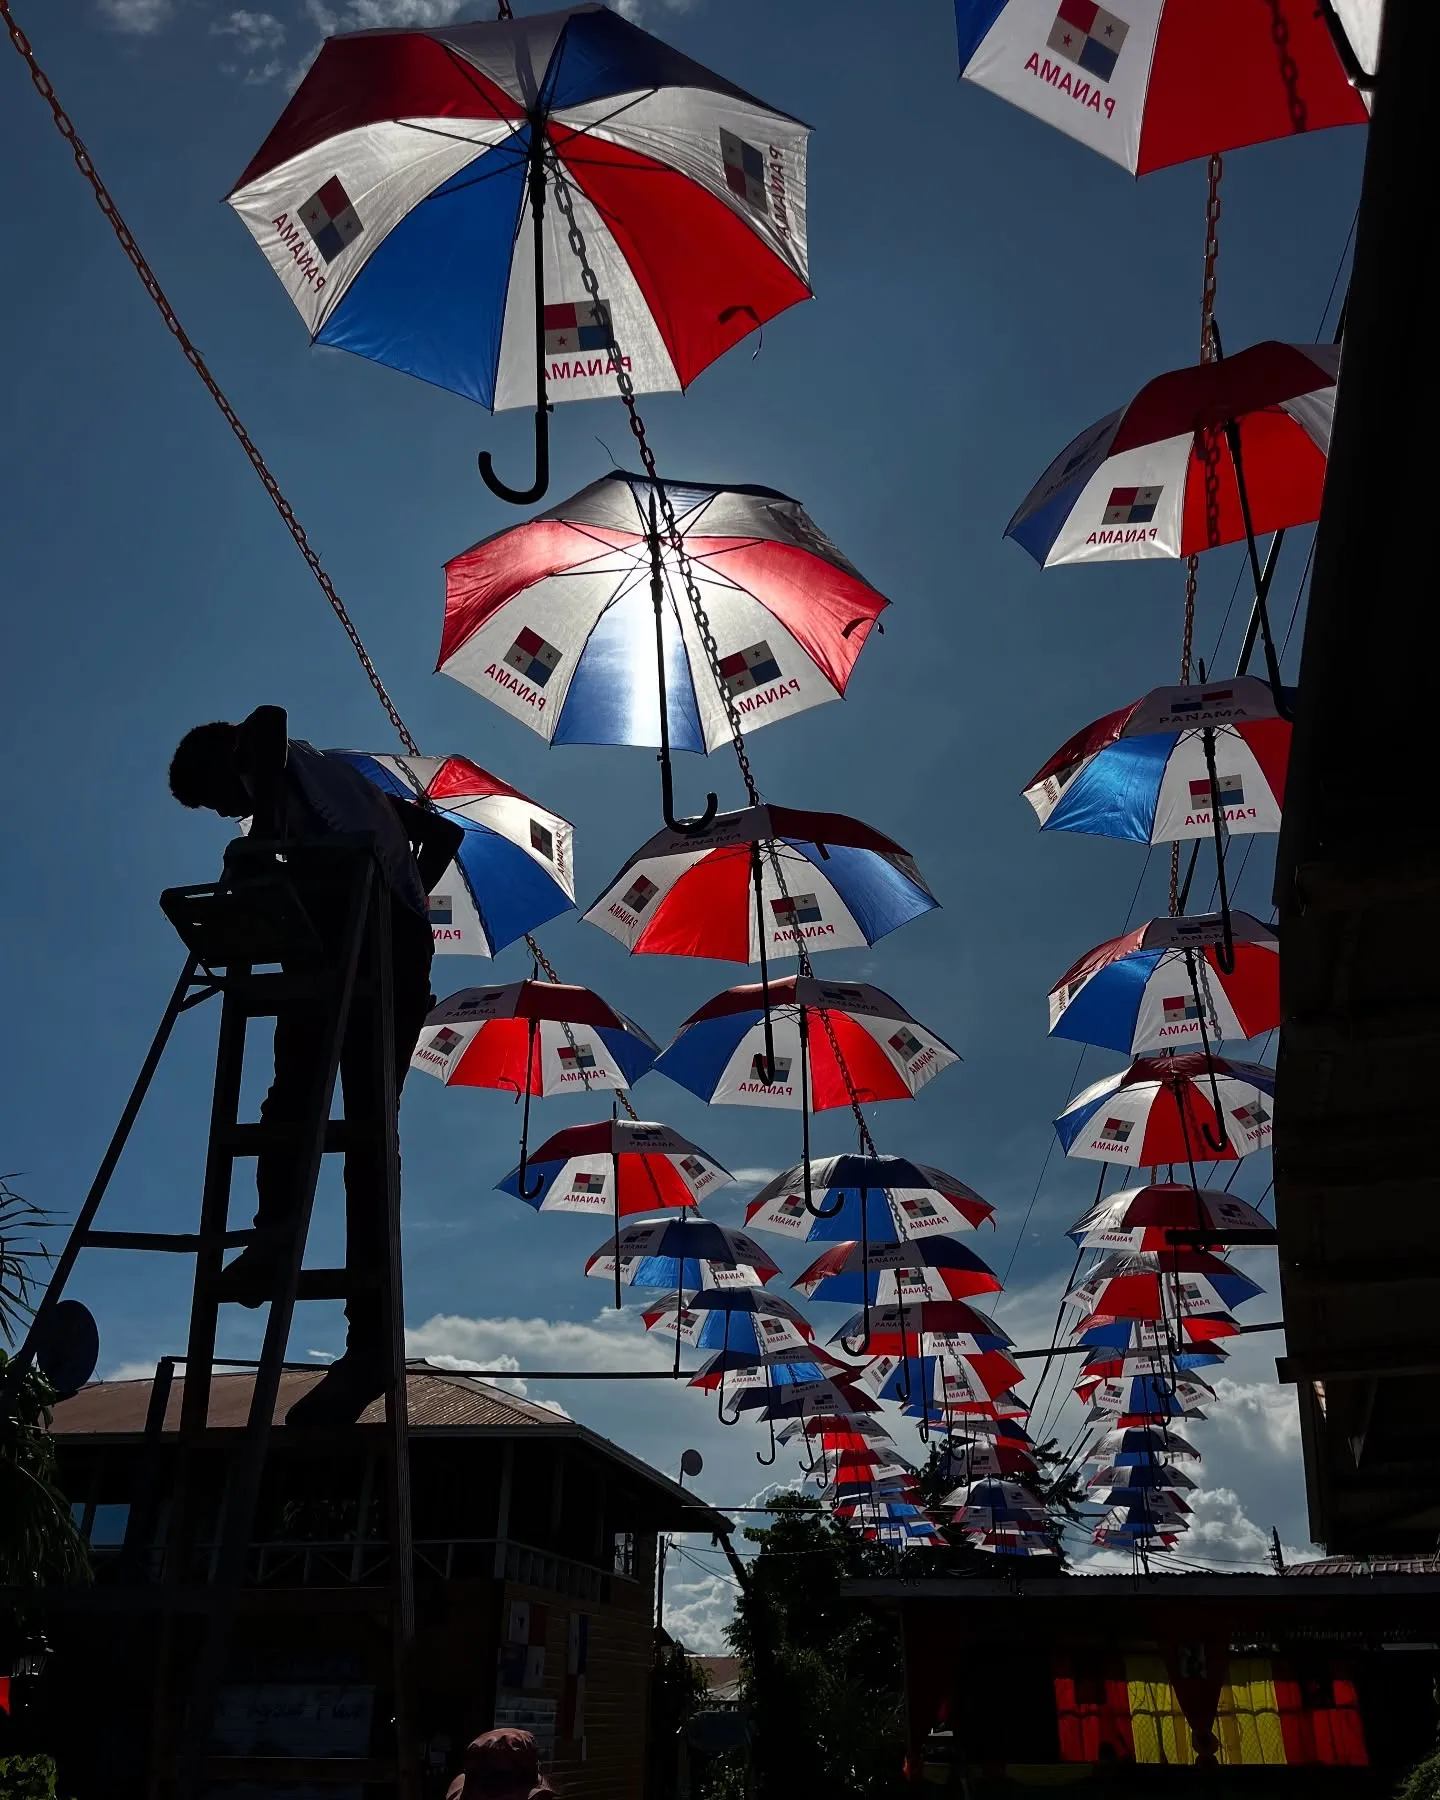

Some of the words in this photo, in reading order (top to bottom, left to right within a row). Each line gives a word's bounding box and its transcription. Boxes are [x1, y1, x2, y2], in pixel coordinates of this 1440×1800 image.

[1159, 708, 1248, 724] PANAMA
[669, 833, 742, 849] PANAMA
[445, 1008, 496, 1017] PANAMA
